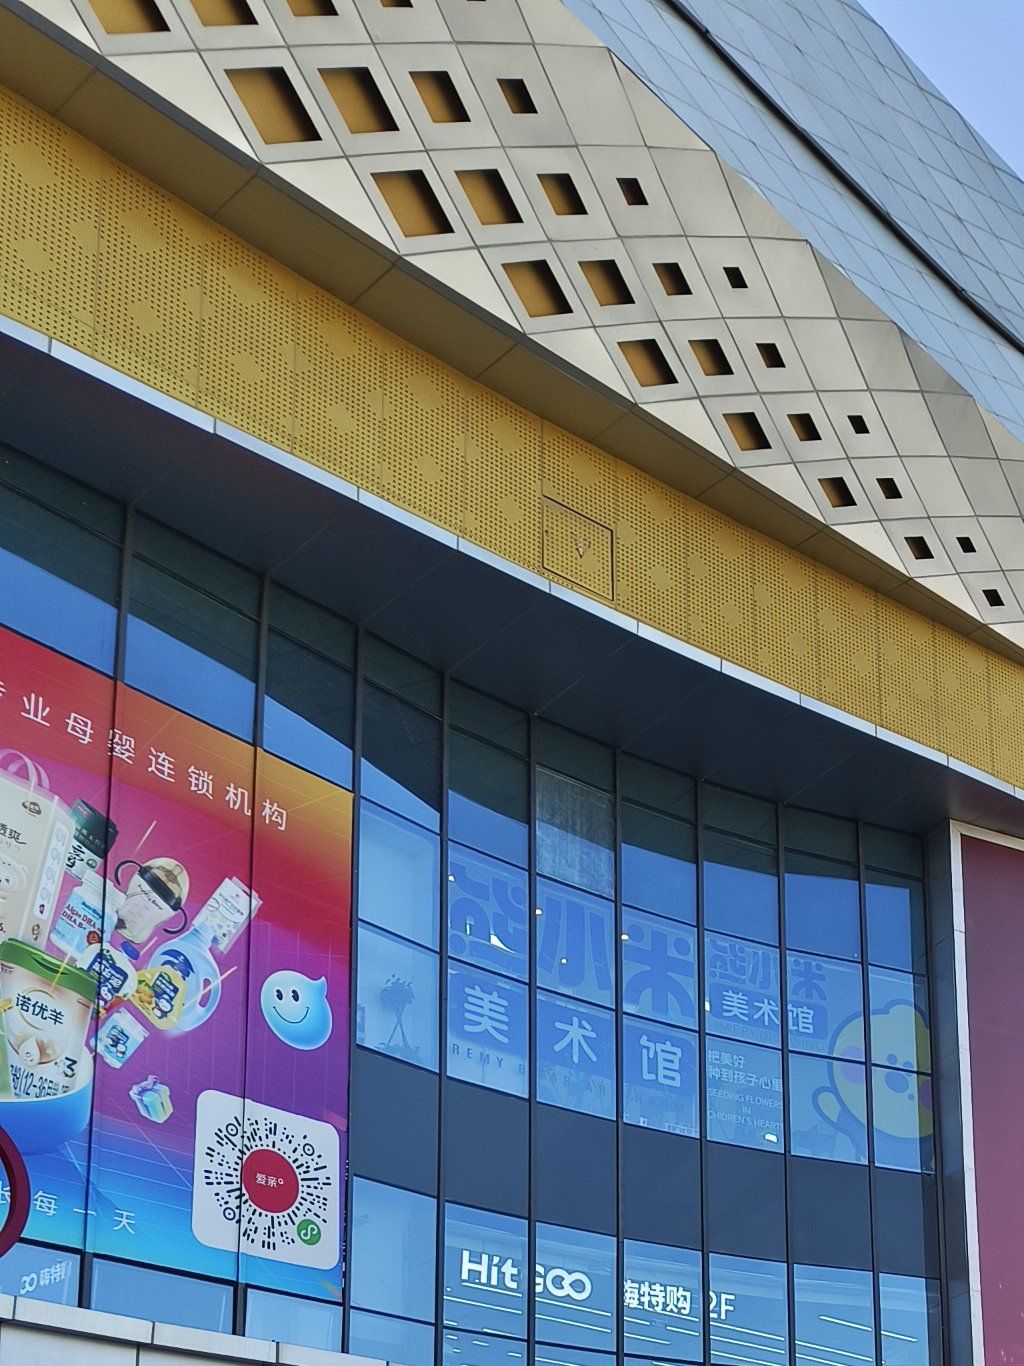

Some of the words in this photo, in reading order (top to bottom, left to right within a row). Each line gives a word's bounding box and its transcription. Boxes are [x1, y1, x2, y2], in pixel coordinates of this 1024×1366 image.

[0, 681, 287, 831] 业母婴连锁机构
[463, 984, 682, 1088] 美术馆
[721, 989, 815, 1034] 美术馆
